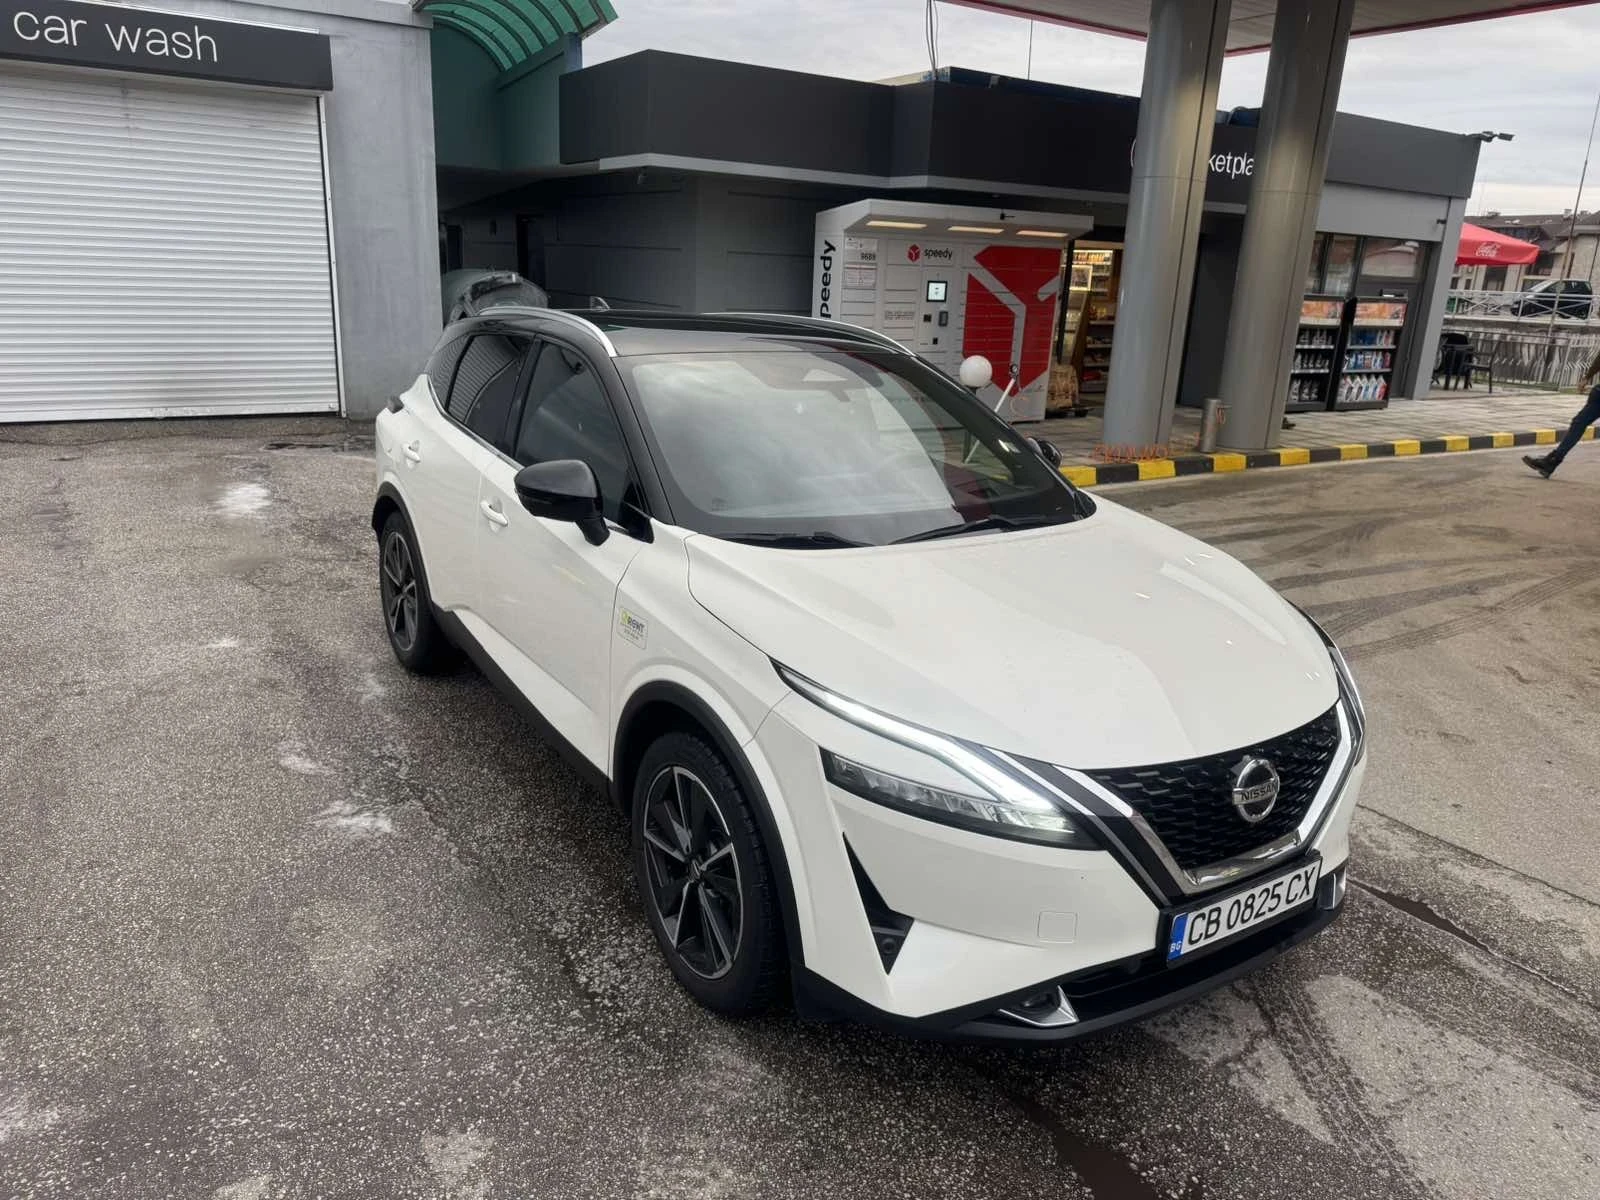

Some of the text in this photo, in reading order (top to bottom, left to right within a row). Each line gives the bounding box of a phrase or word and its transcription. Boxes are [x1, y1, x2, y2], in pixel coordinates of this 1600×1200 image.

[14, 11, 218, 62] car wash
[1208, 152, 1254, 179] ketpla
[924, 248, 953, 260] speedy
[820, 240, 836, 318] peedy
[1242, 784, 1277, 802] NISSAN
[1189, 866, 1316, 945] CB 0825 CX
[1170, 942, 1182, 953] BG
